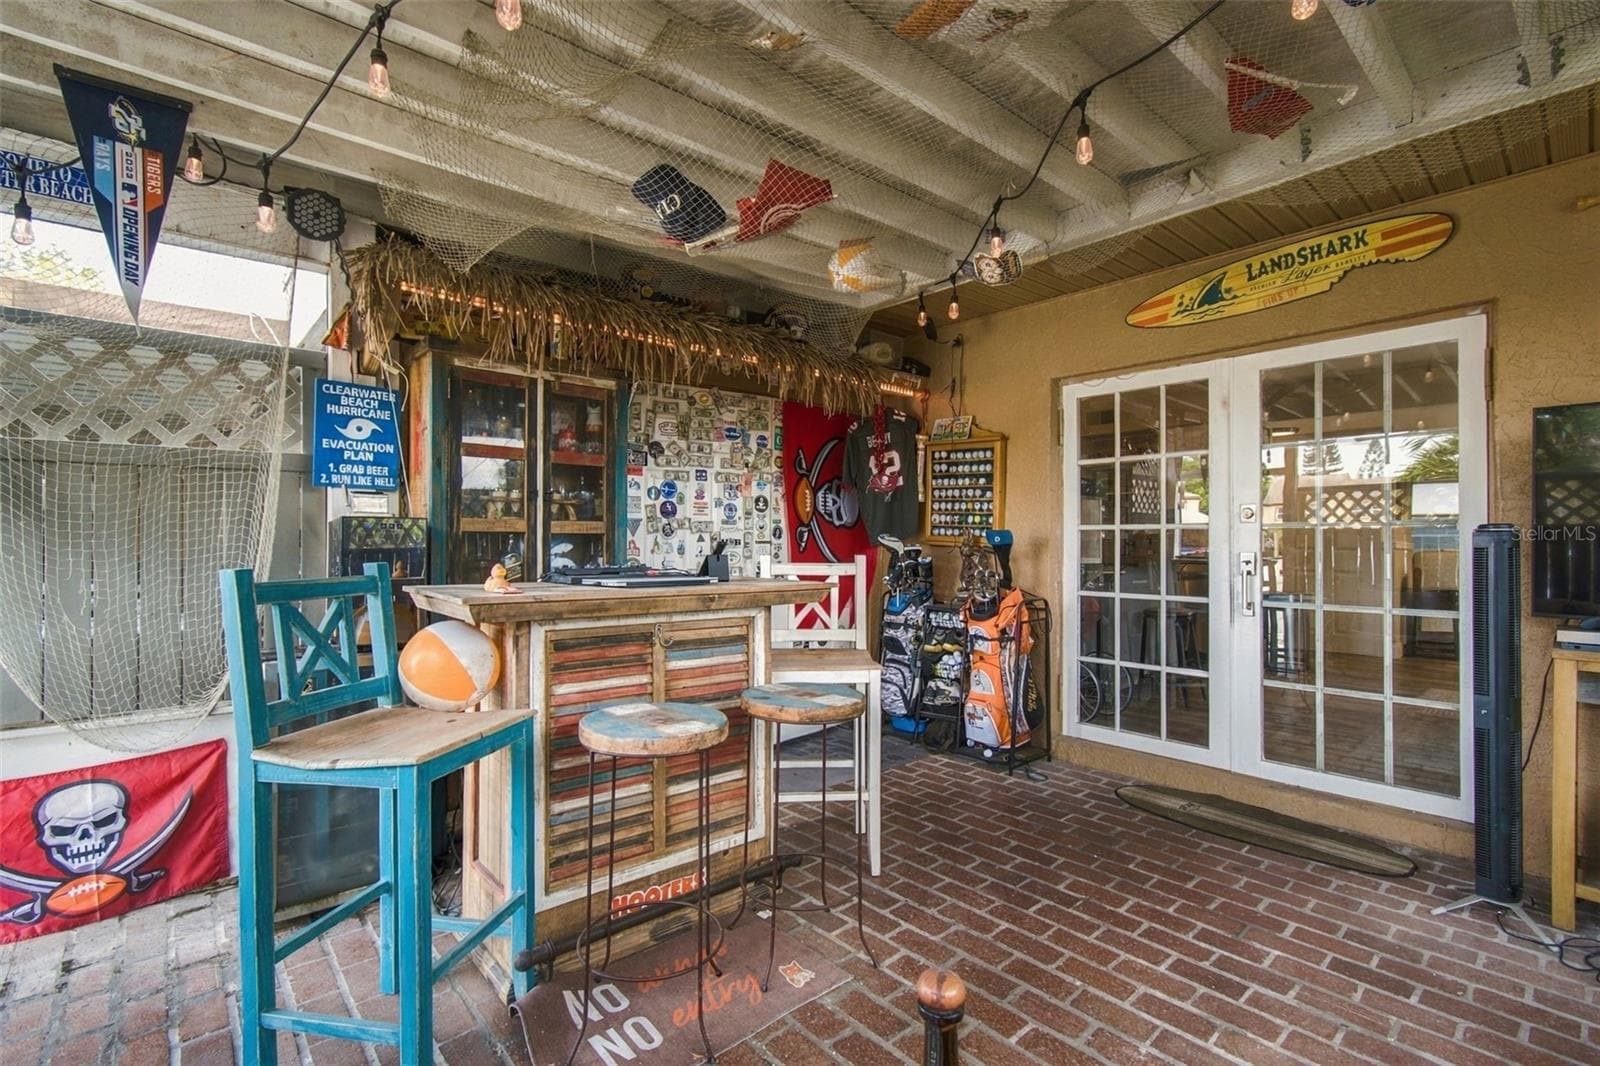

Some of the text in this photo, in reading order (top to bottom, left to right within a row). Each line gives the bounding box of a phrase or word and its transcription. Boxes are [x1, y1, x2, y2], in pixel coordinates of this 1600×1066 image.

[95, 142, 111, 172] RAYS
[147, 156, 161, 195] TIGERS
[38, 177, 95, 204] BEACH
[122, 206, 139, 287] OPENING DAY
[1246, 229, 1369, 282] LANDSHARK
[1280, 265, 1331, 284] Lager
[322, 384, 396, 402] CLEARWATER
[340, 396, 379, 409] BEACH
[326, 404, 391, 420] HURRICANE
[322, 438, 394, 454] EVACUATION
[343, 450, 374, 462] PLAN
[328, 462, 389, 476] 1. GRAB BEER
[320, 473, 396, 487] 2. RUN LIKE HELL
[562, 983, 630, 1031] NO
[587, 1016, 664, 1066] NO
